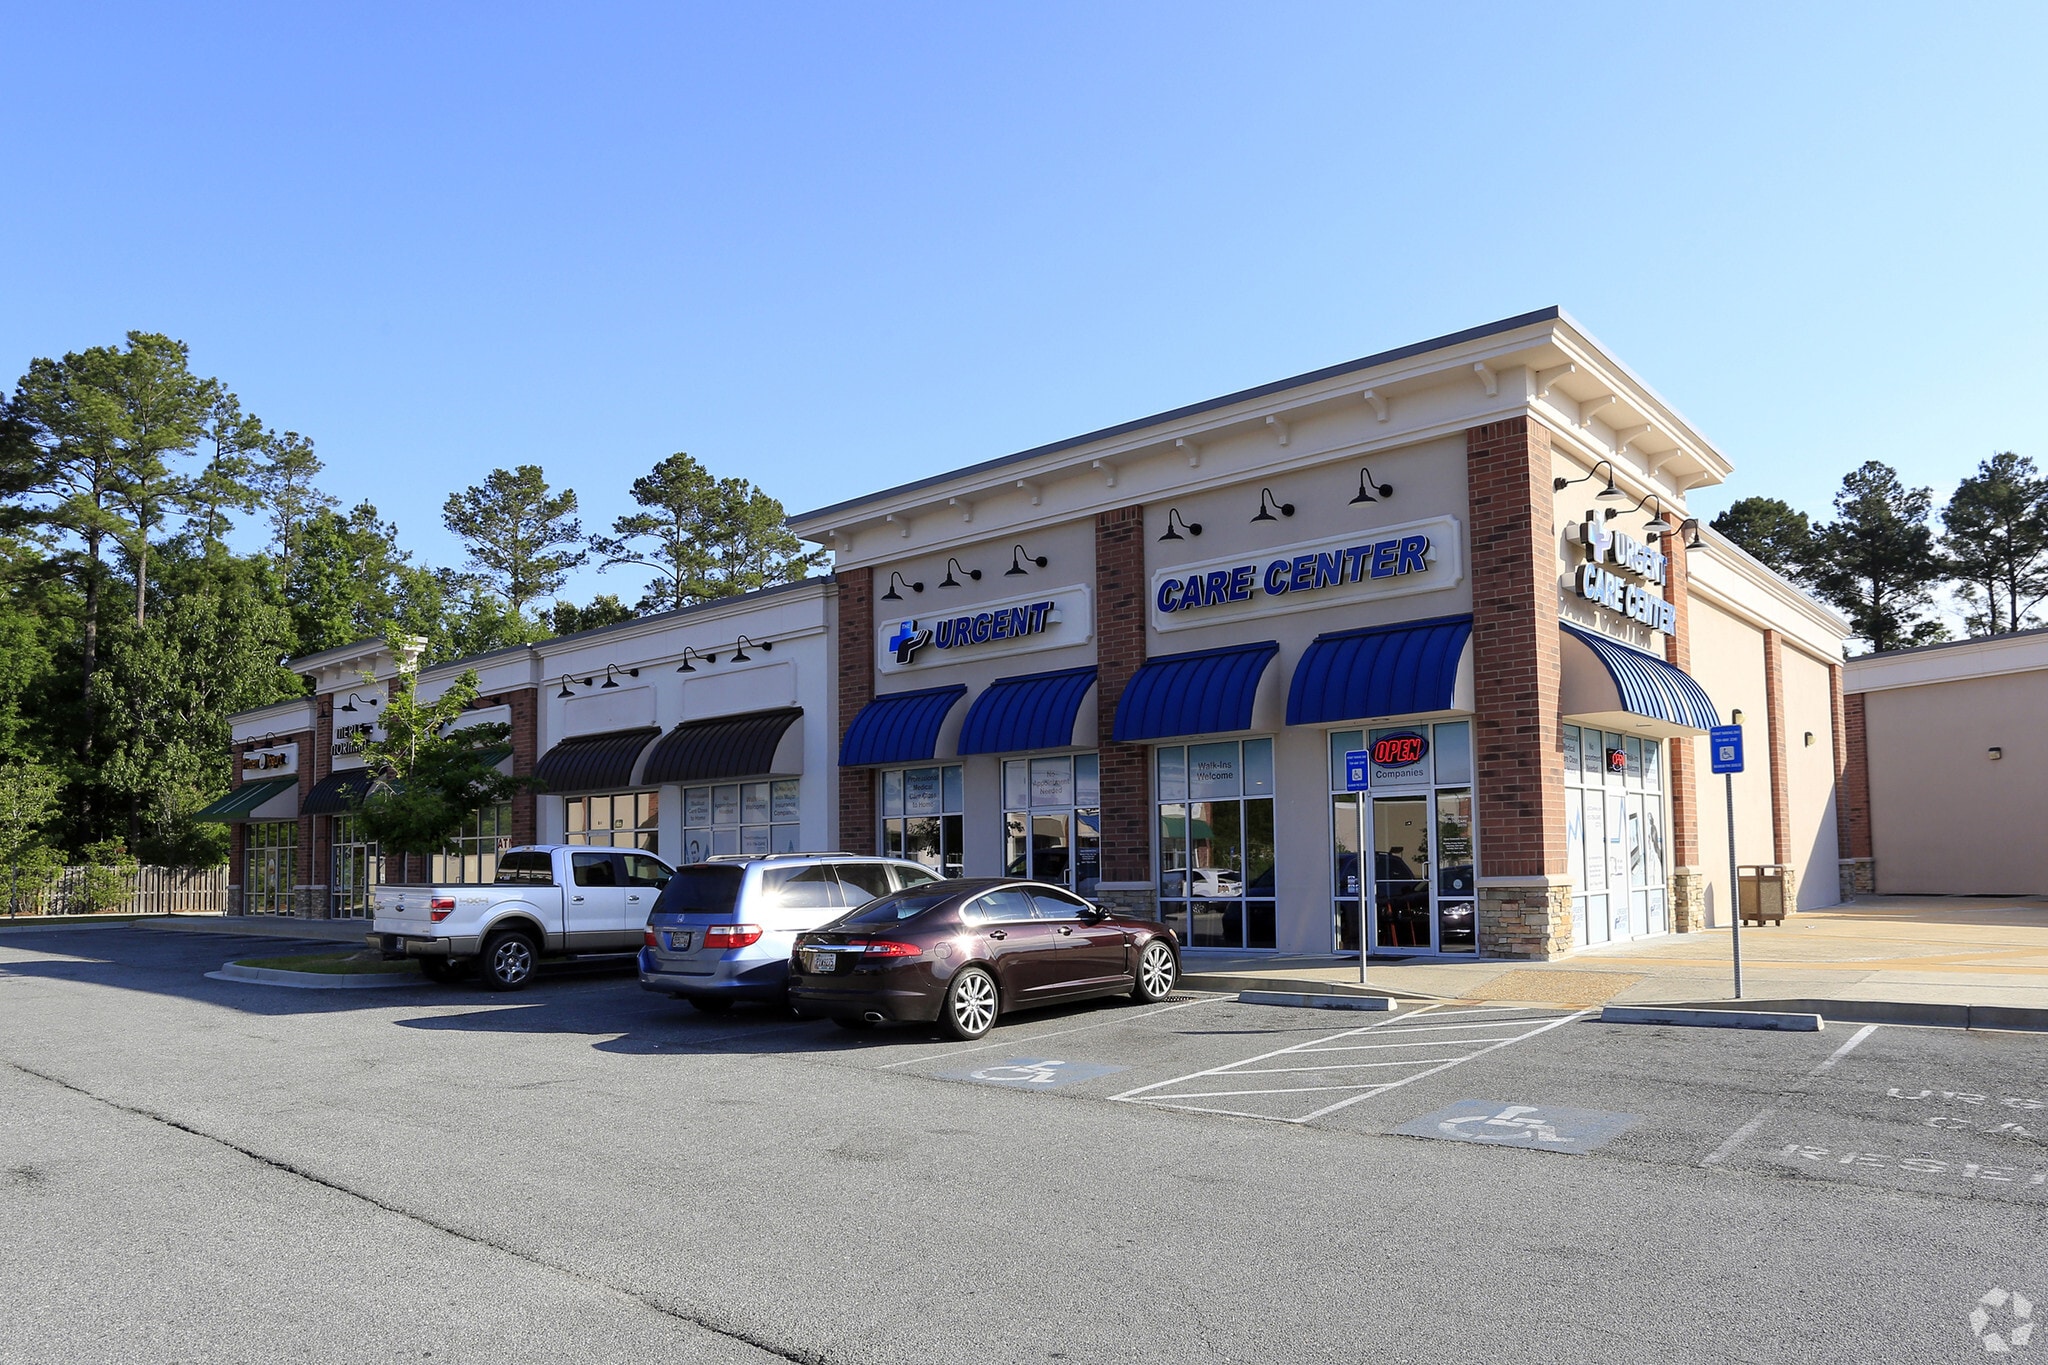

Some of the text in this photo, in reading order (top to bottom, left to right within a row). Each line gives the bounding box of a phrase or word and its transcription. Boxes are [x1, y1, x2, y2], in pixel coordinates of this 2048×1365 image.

[1613, 531, 1667, 586] URGENT
[1157, 534, 1429, 613] CARE CENTER
[1580, 562, 1676, 636] CARE CENTER
[934, 601, 1053, 649] URGENT
[1374, 738, 1422, 763] OPEN
[1198, 760, 1232, 770] Walk-Ins
[1376, 768, 1424, 780] Companies
[1197, 771, 1234, 781] Welcome
[912, 783, 933, 791] Medical
[1039, 786, 1063, 795] Needed
